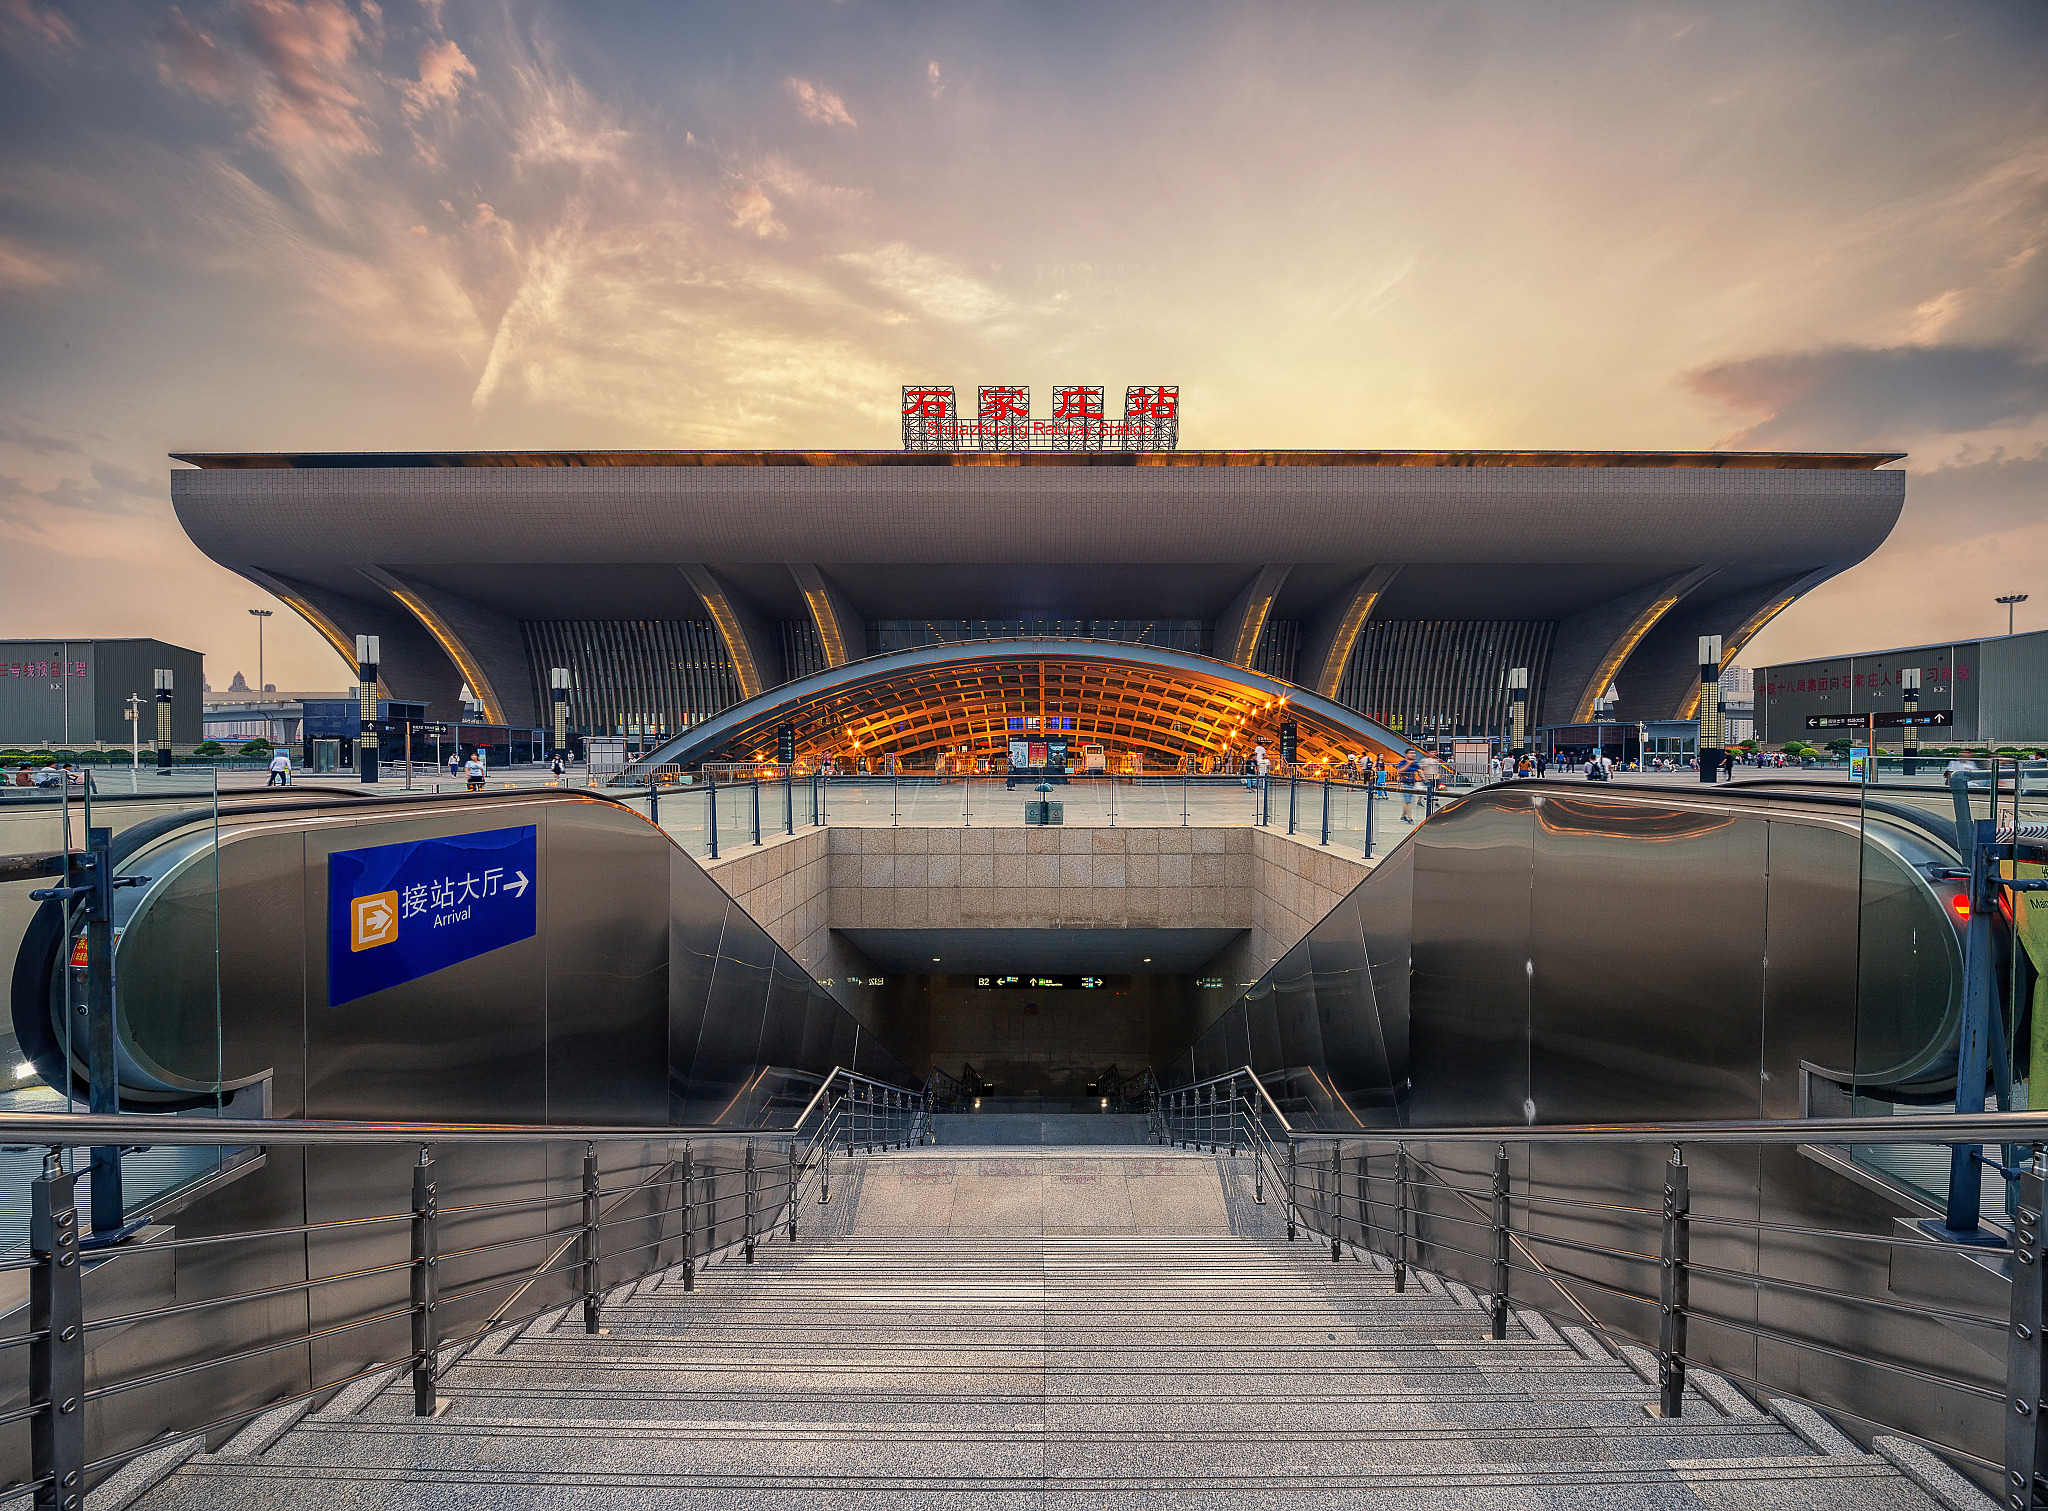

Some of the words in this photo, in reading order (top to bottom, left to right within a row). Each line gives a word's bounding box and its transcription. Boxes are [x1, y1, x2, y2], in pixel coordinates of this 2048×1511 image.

[901, 386, 1179, 420] 石家庄站
[927, 421, 1028, 439] Shijiazhuang
[1033, 421, 1093, 438] Railway
[1097, 421, 1152, 437] Station
[0, 661, 87, 678] 三号线预留工程
[1757, 664, 1970, 697] 中铁十八局集团向石家庄人民习致敬
[402, 867, 504, 919] 接站大厅
[433, 904, 471, 929] Arrival
[978, 977, 990, 986] B2
